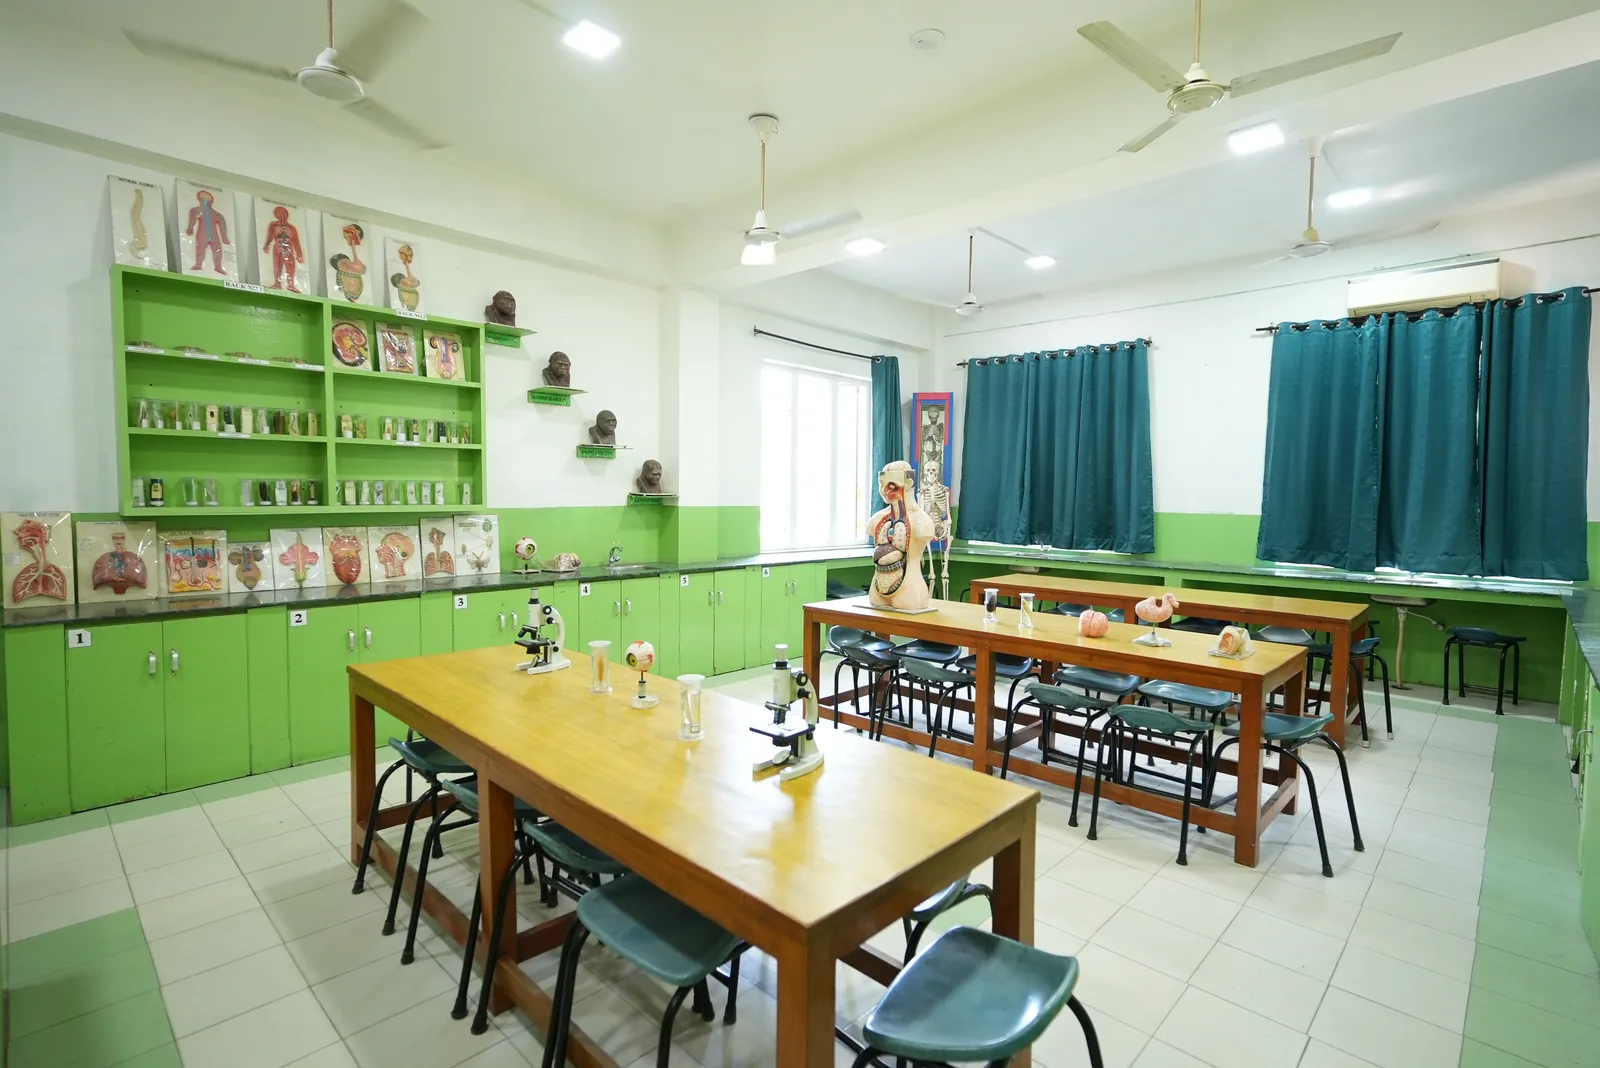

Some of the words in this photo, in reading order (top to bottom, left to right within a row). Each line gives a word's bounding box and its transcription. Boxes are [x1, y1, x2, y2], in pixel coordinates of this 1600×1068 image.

[118, 176, 139, 186] SPINAL
[139, 181, 157, 189] CORD
[225, 281, 246, 289] RACK
[763, 568, 769, 576] 6
[682, 577, 687, 585] 5
[582, 585, 589, 594] 4
[458, 597, 464, 607] 3
[294, 613, 303, 623] 2
[75, 632, 84, 645] 1
